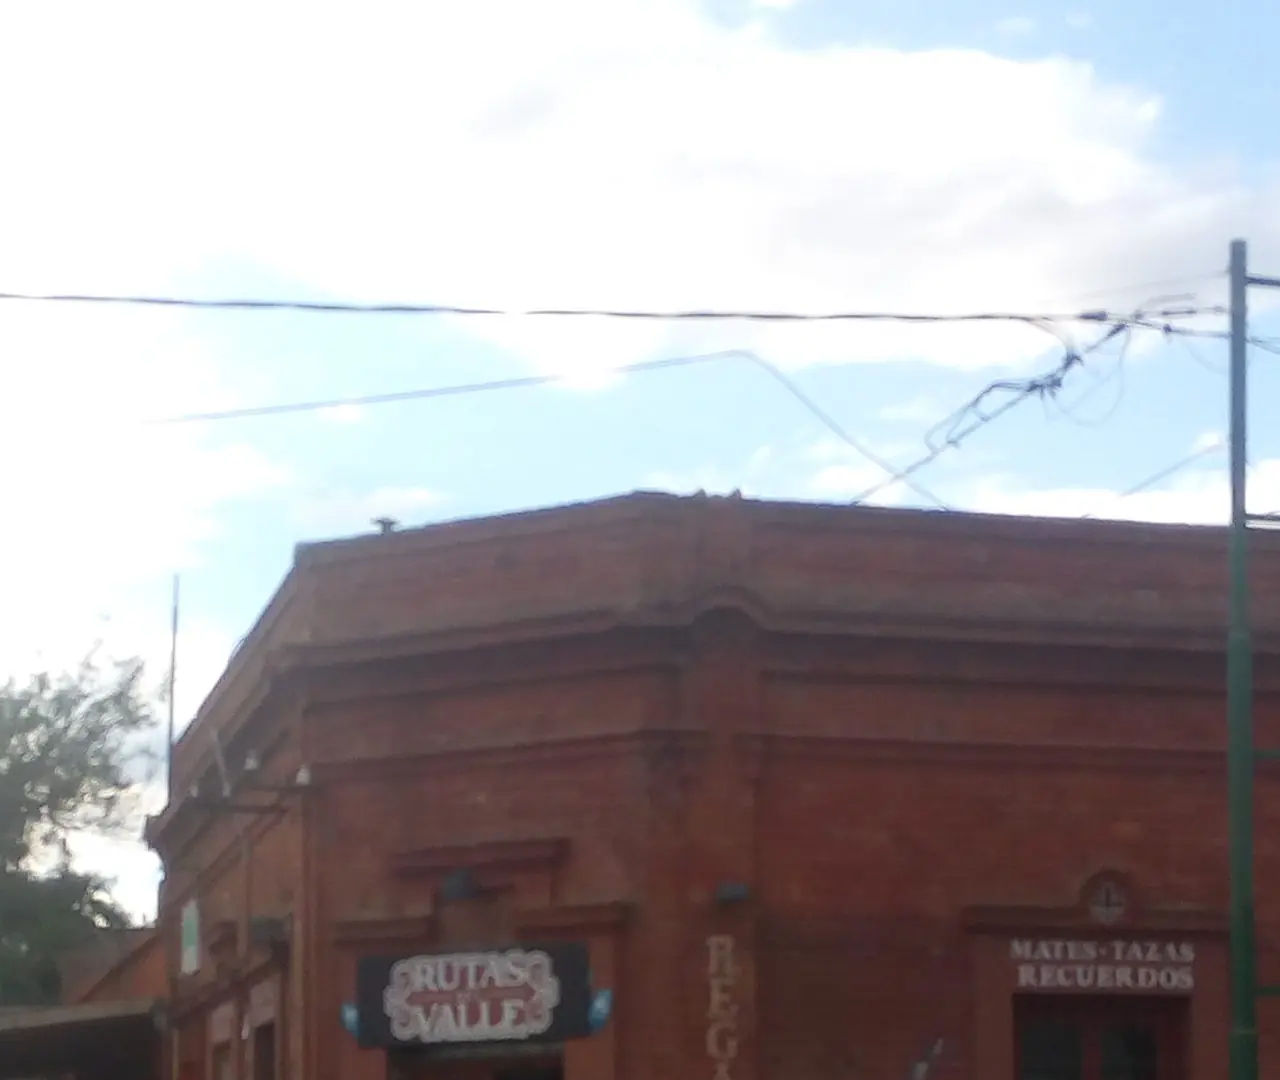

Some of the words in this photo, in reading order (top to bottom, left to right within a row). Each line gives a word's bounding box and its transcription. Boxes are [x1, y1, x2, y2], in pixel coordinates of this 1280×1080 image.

[412, 957, 528, 991] RUTAS
[1017, 964, 1194, 988] RECUERDOS
[414, 999, 528, 1035] VALLE
